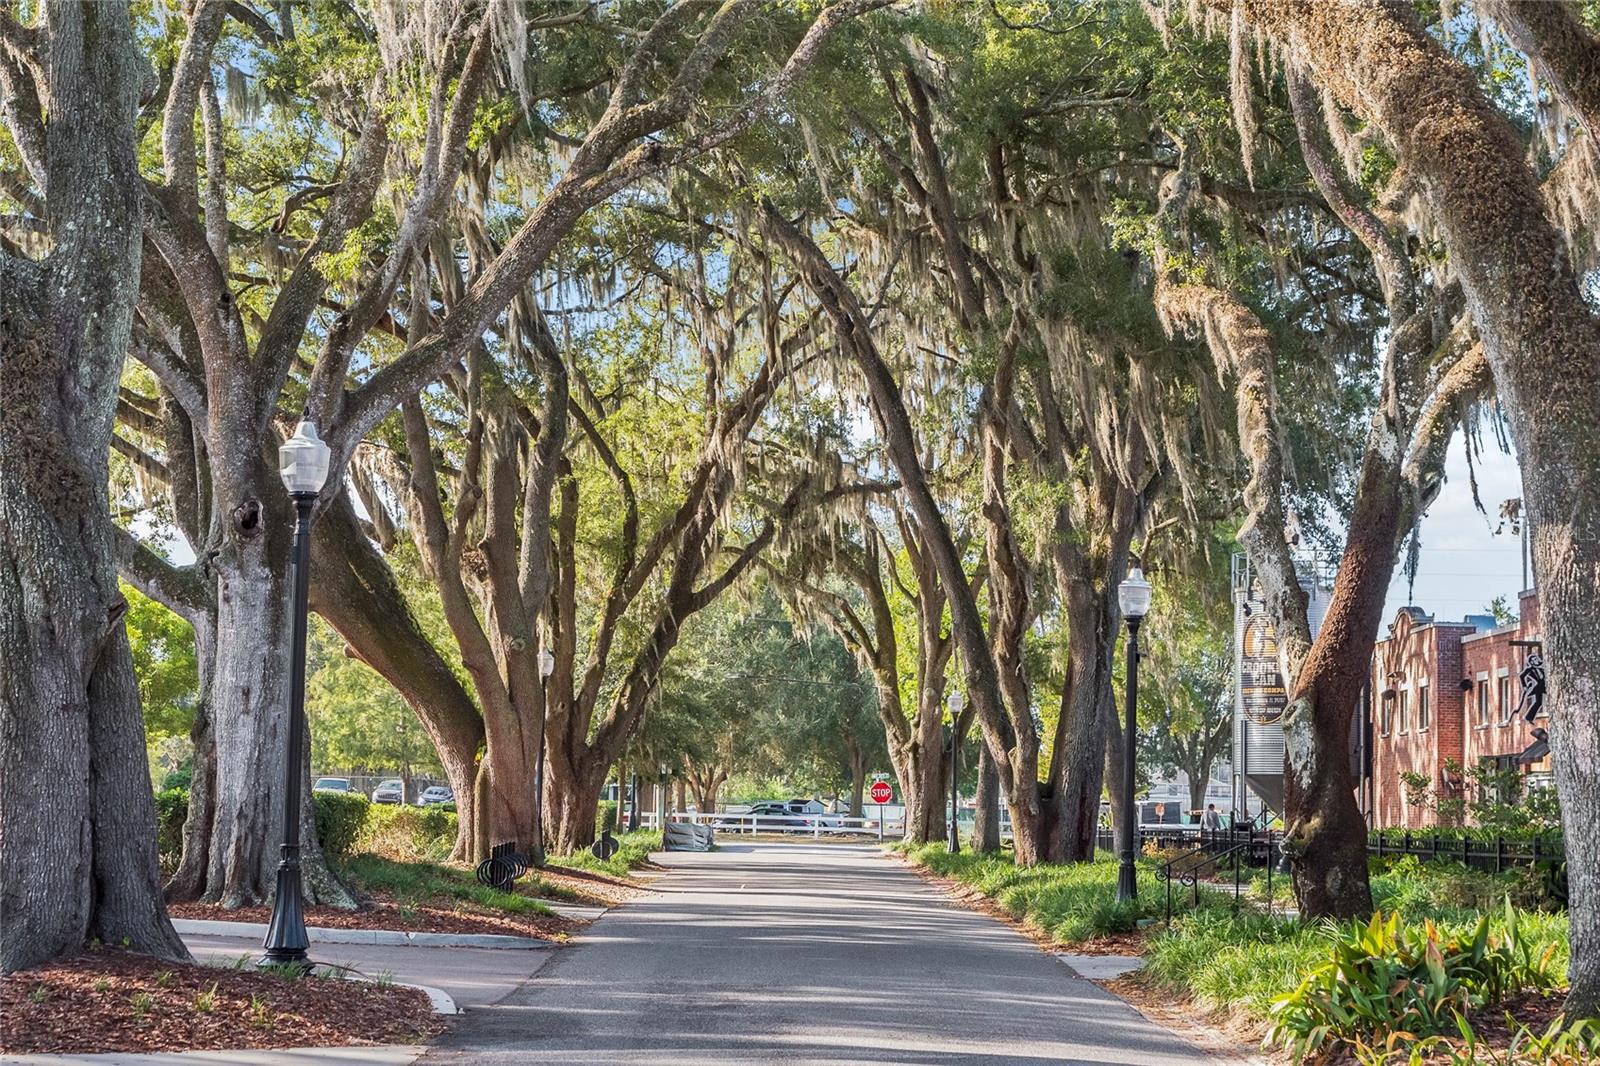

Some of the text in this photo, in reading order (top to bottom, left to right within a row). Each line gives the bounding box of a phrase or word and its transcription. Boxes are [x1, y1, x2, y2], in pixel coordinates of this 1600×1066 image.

[1242, 661, 1279, 674] CROOKE
[1253, 674, 1276, 686] CAN
[872, 788, 891, 798] STOP
